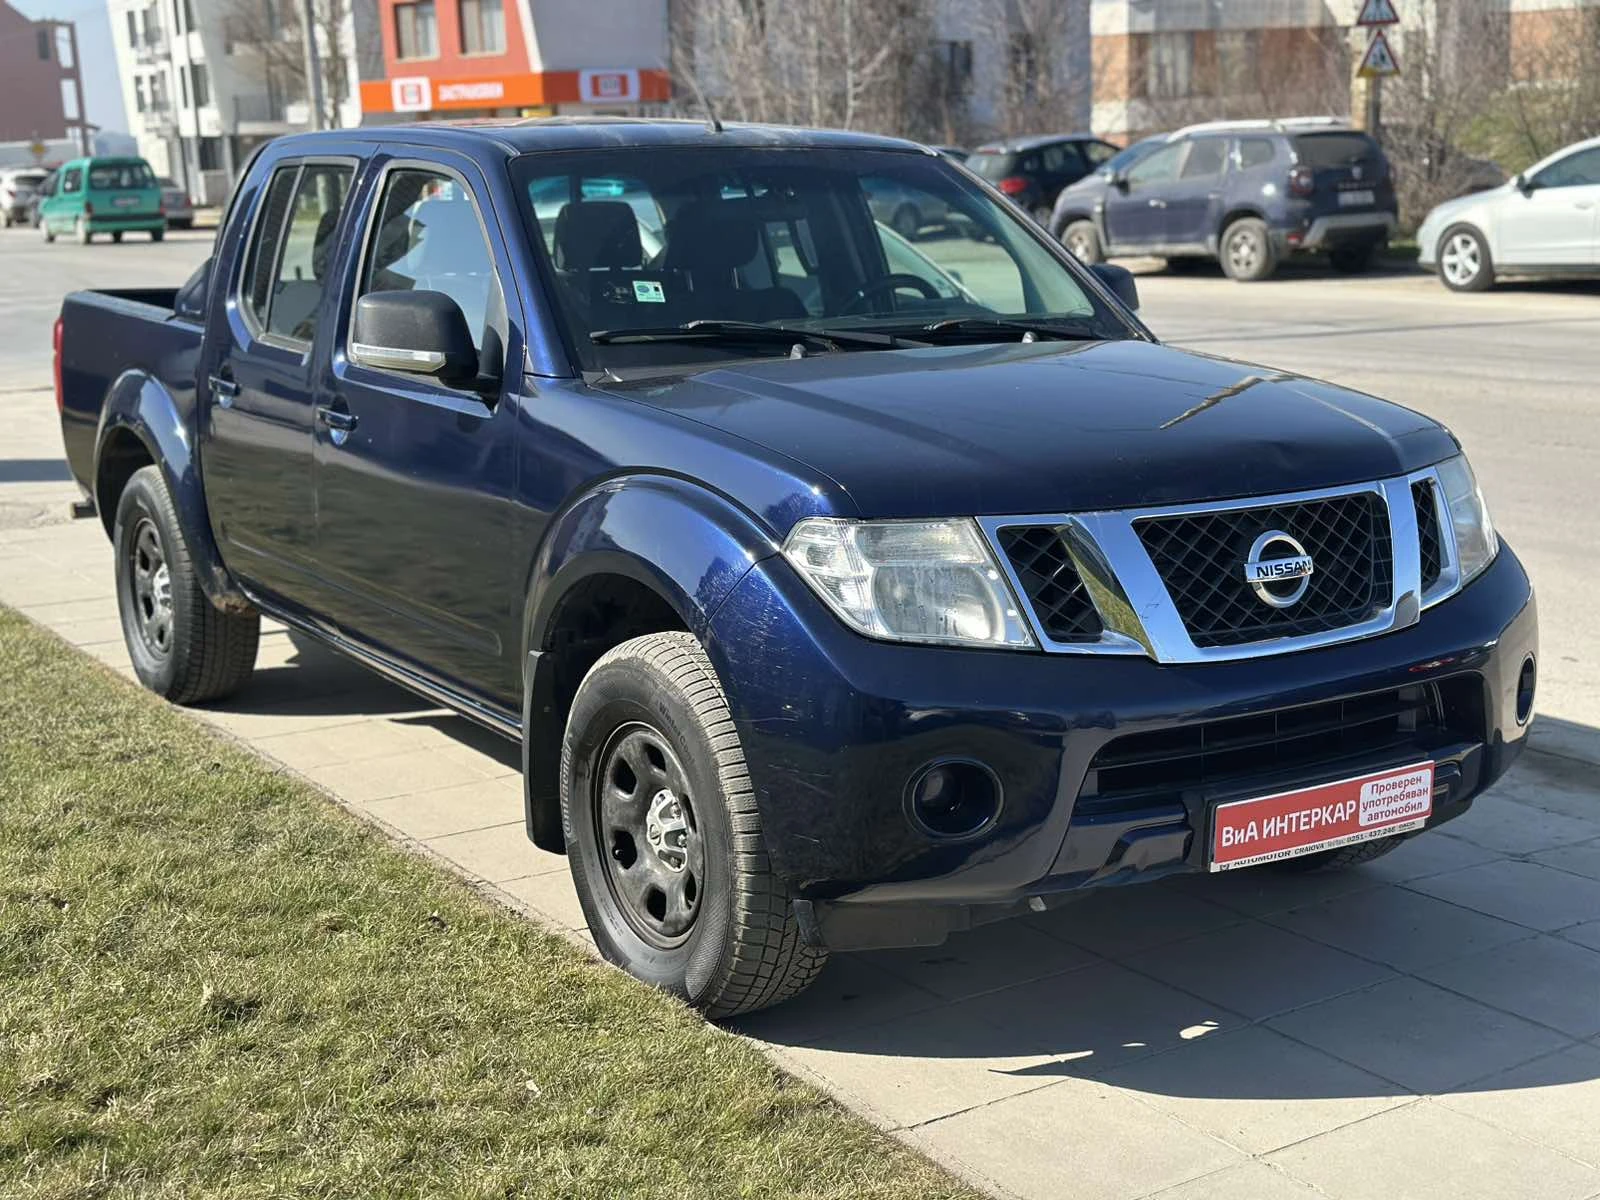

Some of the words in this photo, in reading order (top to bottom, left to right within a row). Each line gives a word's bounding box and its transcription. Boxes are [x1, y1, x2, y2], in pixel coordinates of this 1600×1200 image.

[1256, 560, 1311, 577] NISSAN
[1370, 775, 1422, 796] Проверен
[1361, 787, 1429, 813] употребяван
[1367, 801, 1423, 822] автомобил
[1221, 820, 1259, 848] ВиА
[1262, 799, 1357, 839] ИНТЕРКАР
